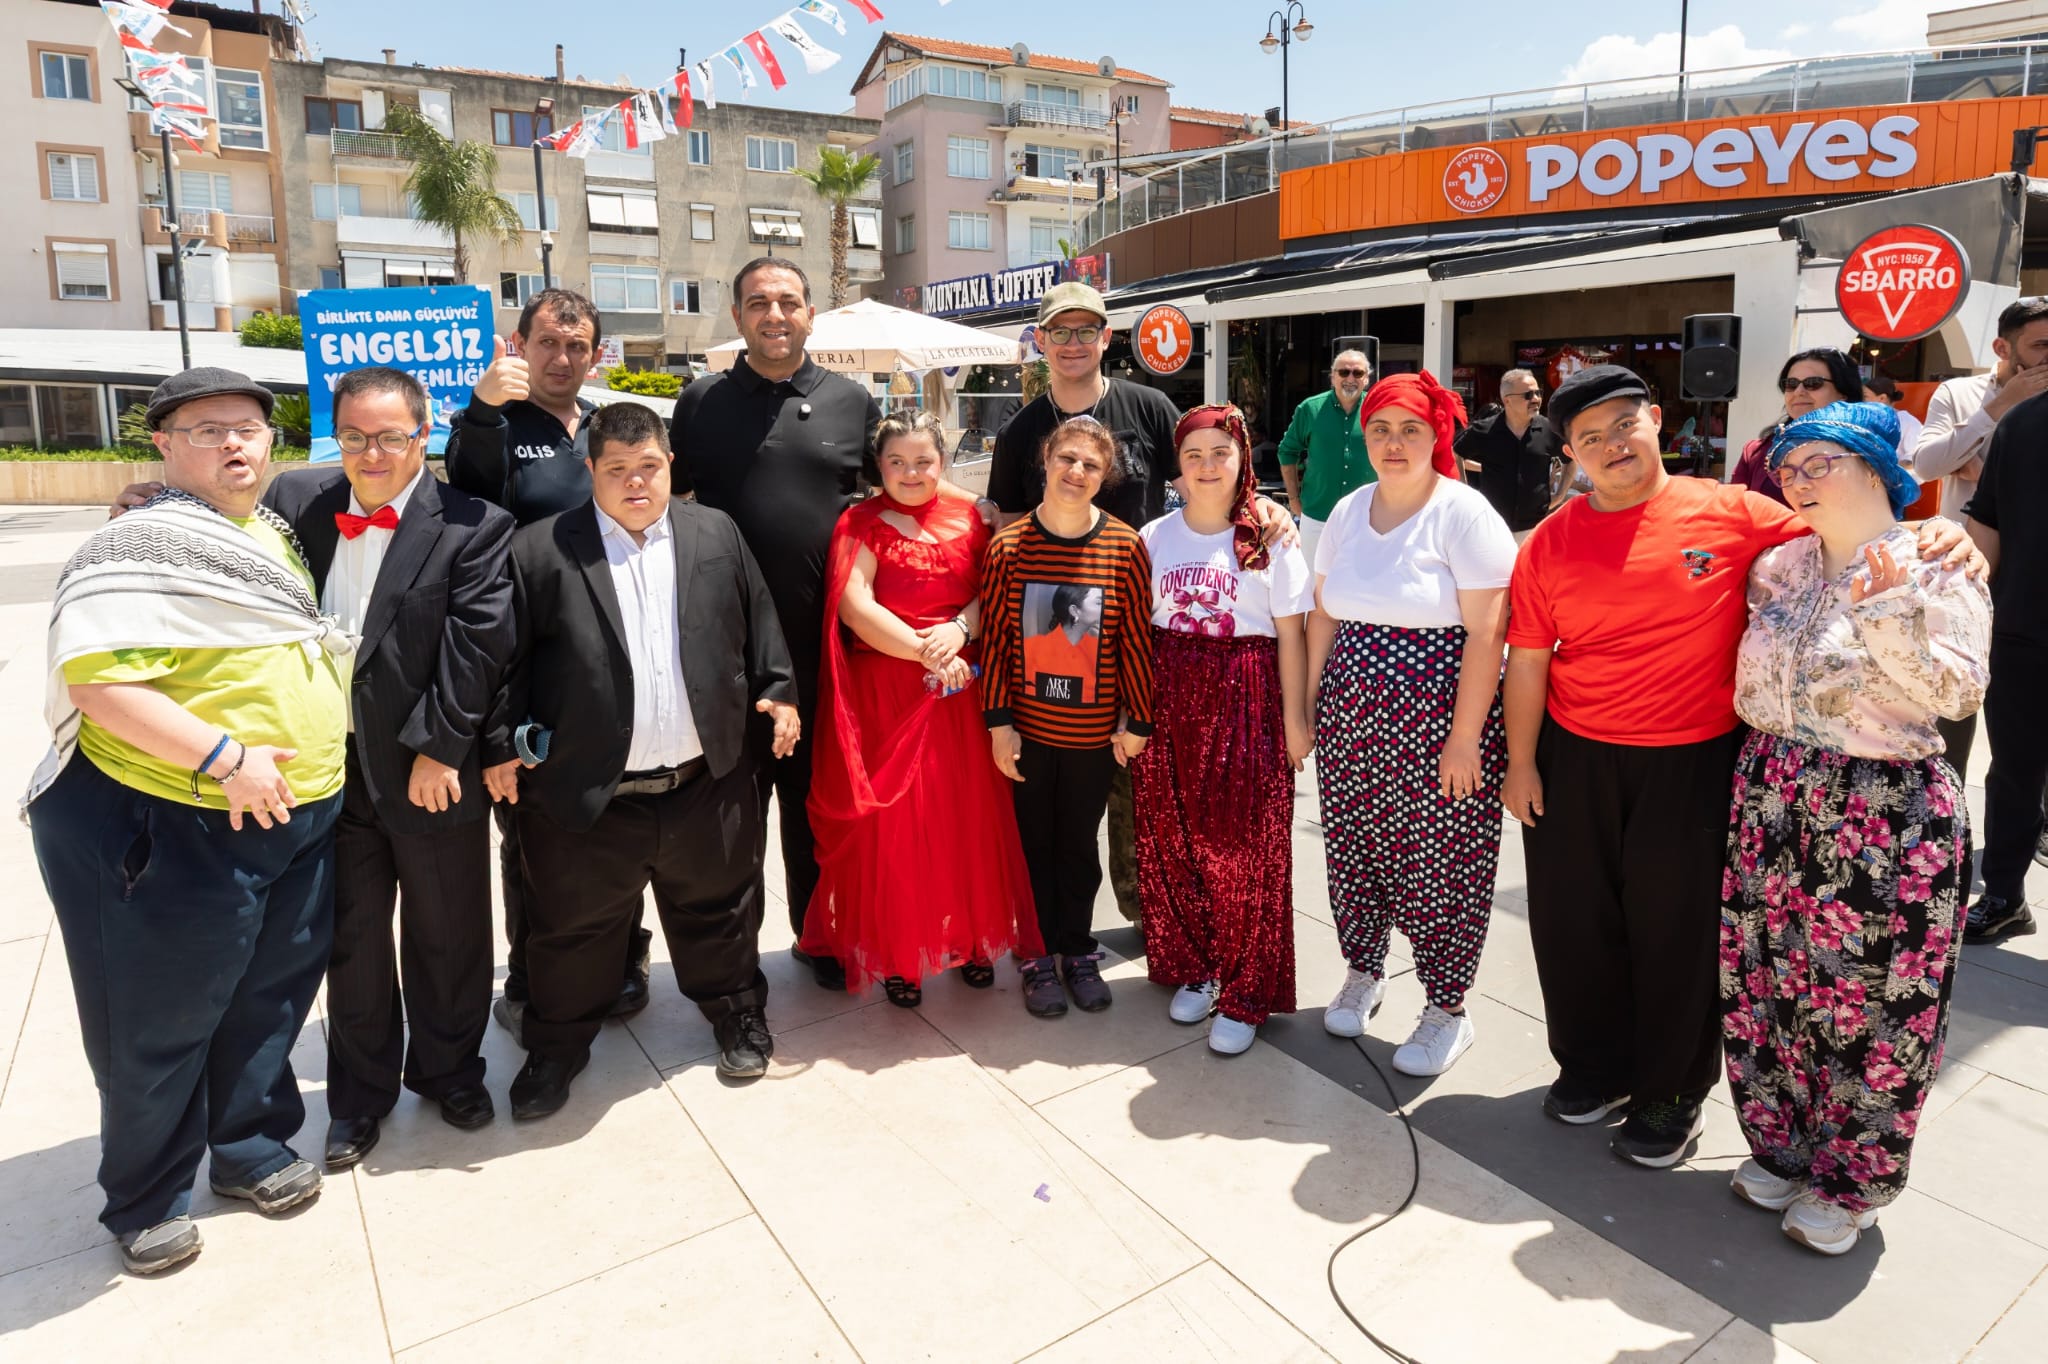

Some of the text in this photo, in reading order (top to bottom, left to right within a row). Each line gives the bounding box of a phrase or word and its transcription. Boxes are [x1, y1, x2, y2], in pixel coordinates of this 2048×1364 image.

[1456, 153, 1496, 168] POPEYES
[1454, 192, 1496, 208] CHICKEN
[1844, 267, 1956, 293] SBARRO
[925, 265, 1056, 315] MONTANA COFFEE
[316, 306, 479, 325] BİRLİKTE DAHA GÜÇLÜYÜZ
[1147, 309, 1184, 325] POPEYES
[319, 322, 484, 366] ENGELSİZ
[929, 346, 1006, 360] LA GELATERIA
[1147, 353, 1185, 371] CHICKEN
[514, 445, 556, 459] OLİS
[1160, 567, 1239, 602] CONFIDENCE
[1047, 677, 1071, 691] ART
